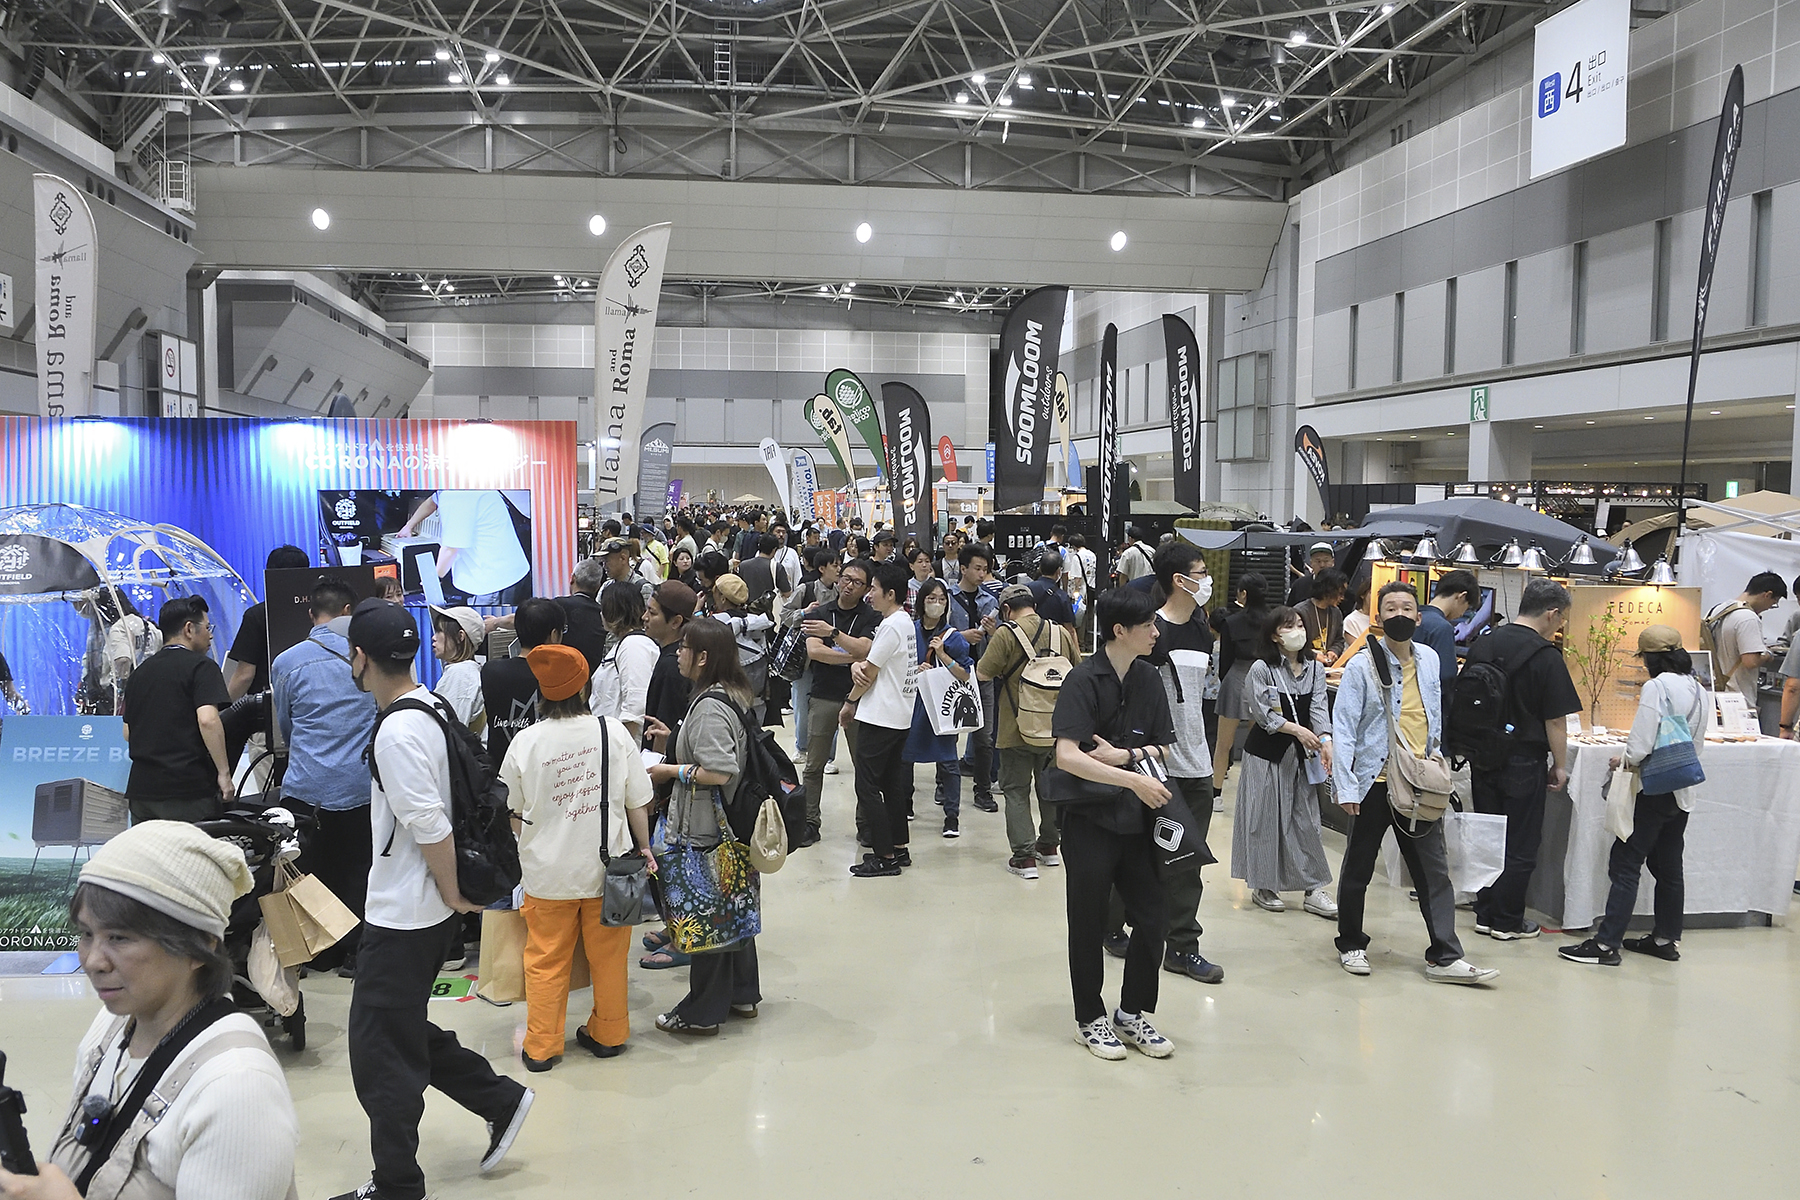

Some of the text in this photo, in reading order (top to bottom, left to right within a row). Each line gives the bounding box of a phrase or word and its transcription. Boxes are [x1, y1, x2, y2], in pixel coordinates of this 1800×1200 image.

[1587, 50, 1606, 70] 出口
[1565, 61, 1583, 103] 4
[1587, 72, 1601, 86] Exit
[1544, 89, 1555, 113] 西
[1016, 319, 1043, 466] SOOMLOOM
[1040, 366, 1054, 420] outdoors
[599, 327, 637, 497] llama and Roma
[1101, 361, 1113, 543] SOOMLOOM
[1609, 601, 1663, 613] FEDECA
[12, 746, 100, 762] BREEZE
[551, 752, 575, 767] matter
[577, 746, 598, 758] where
[554, 779, 566, 789] we
[585, 769, 597, 780] to
[556, 765, 571, 778] you
[565, 804, 599, 821] together
[432, 983, 452, 996] 8
